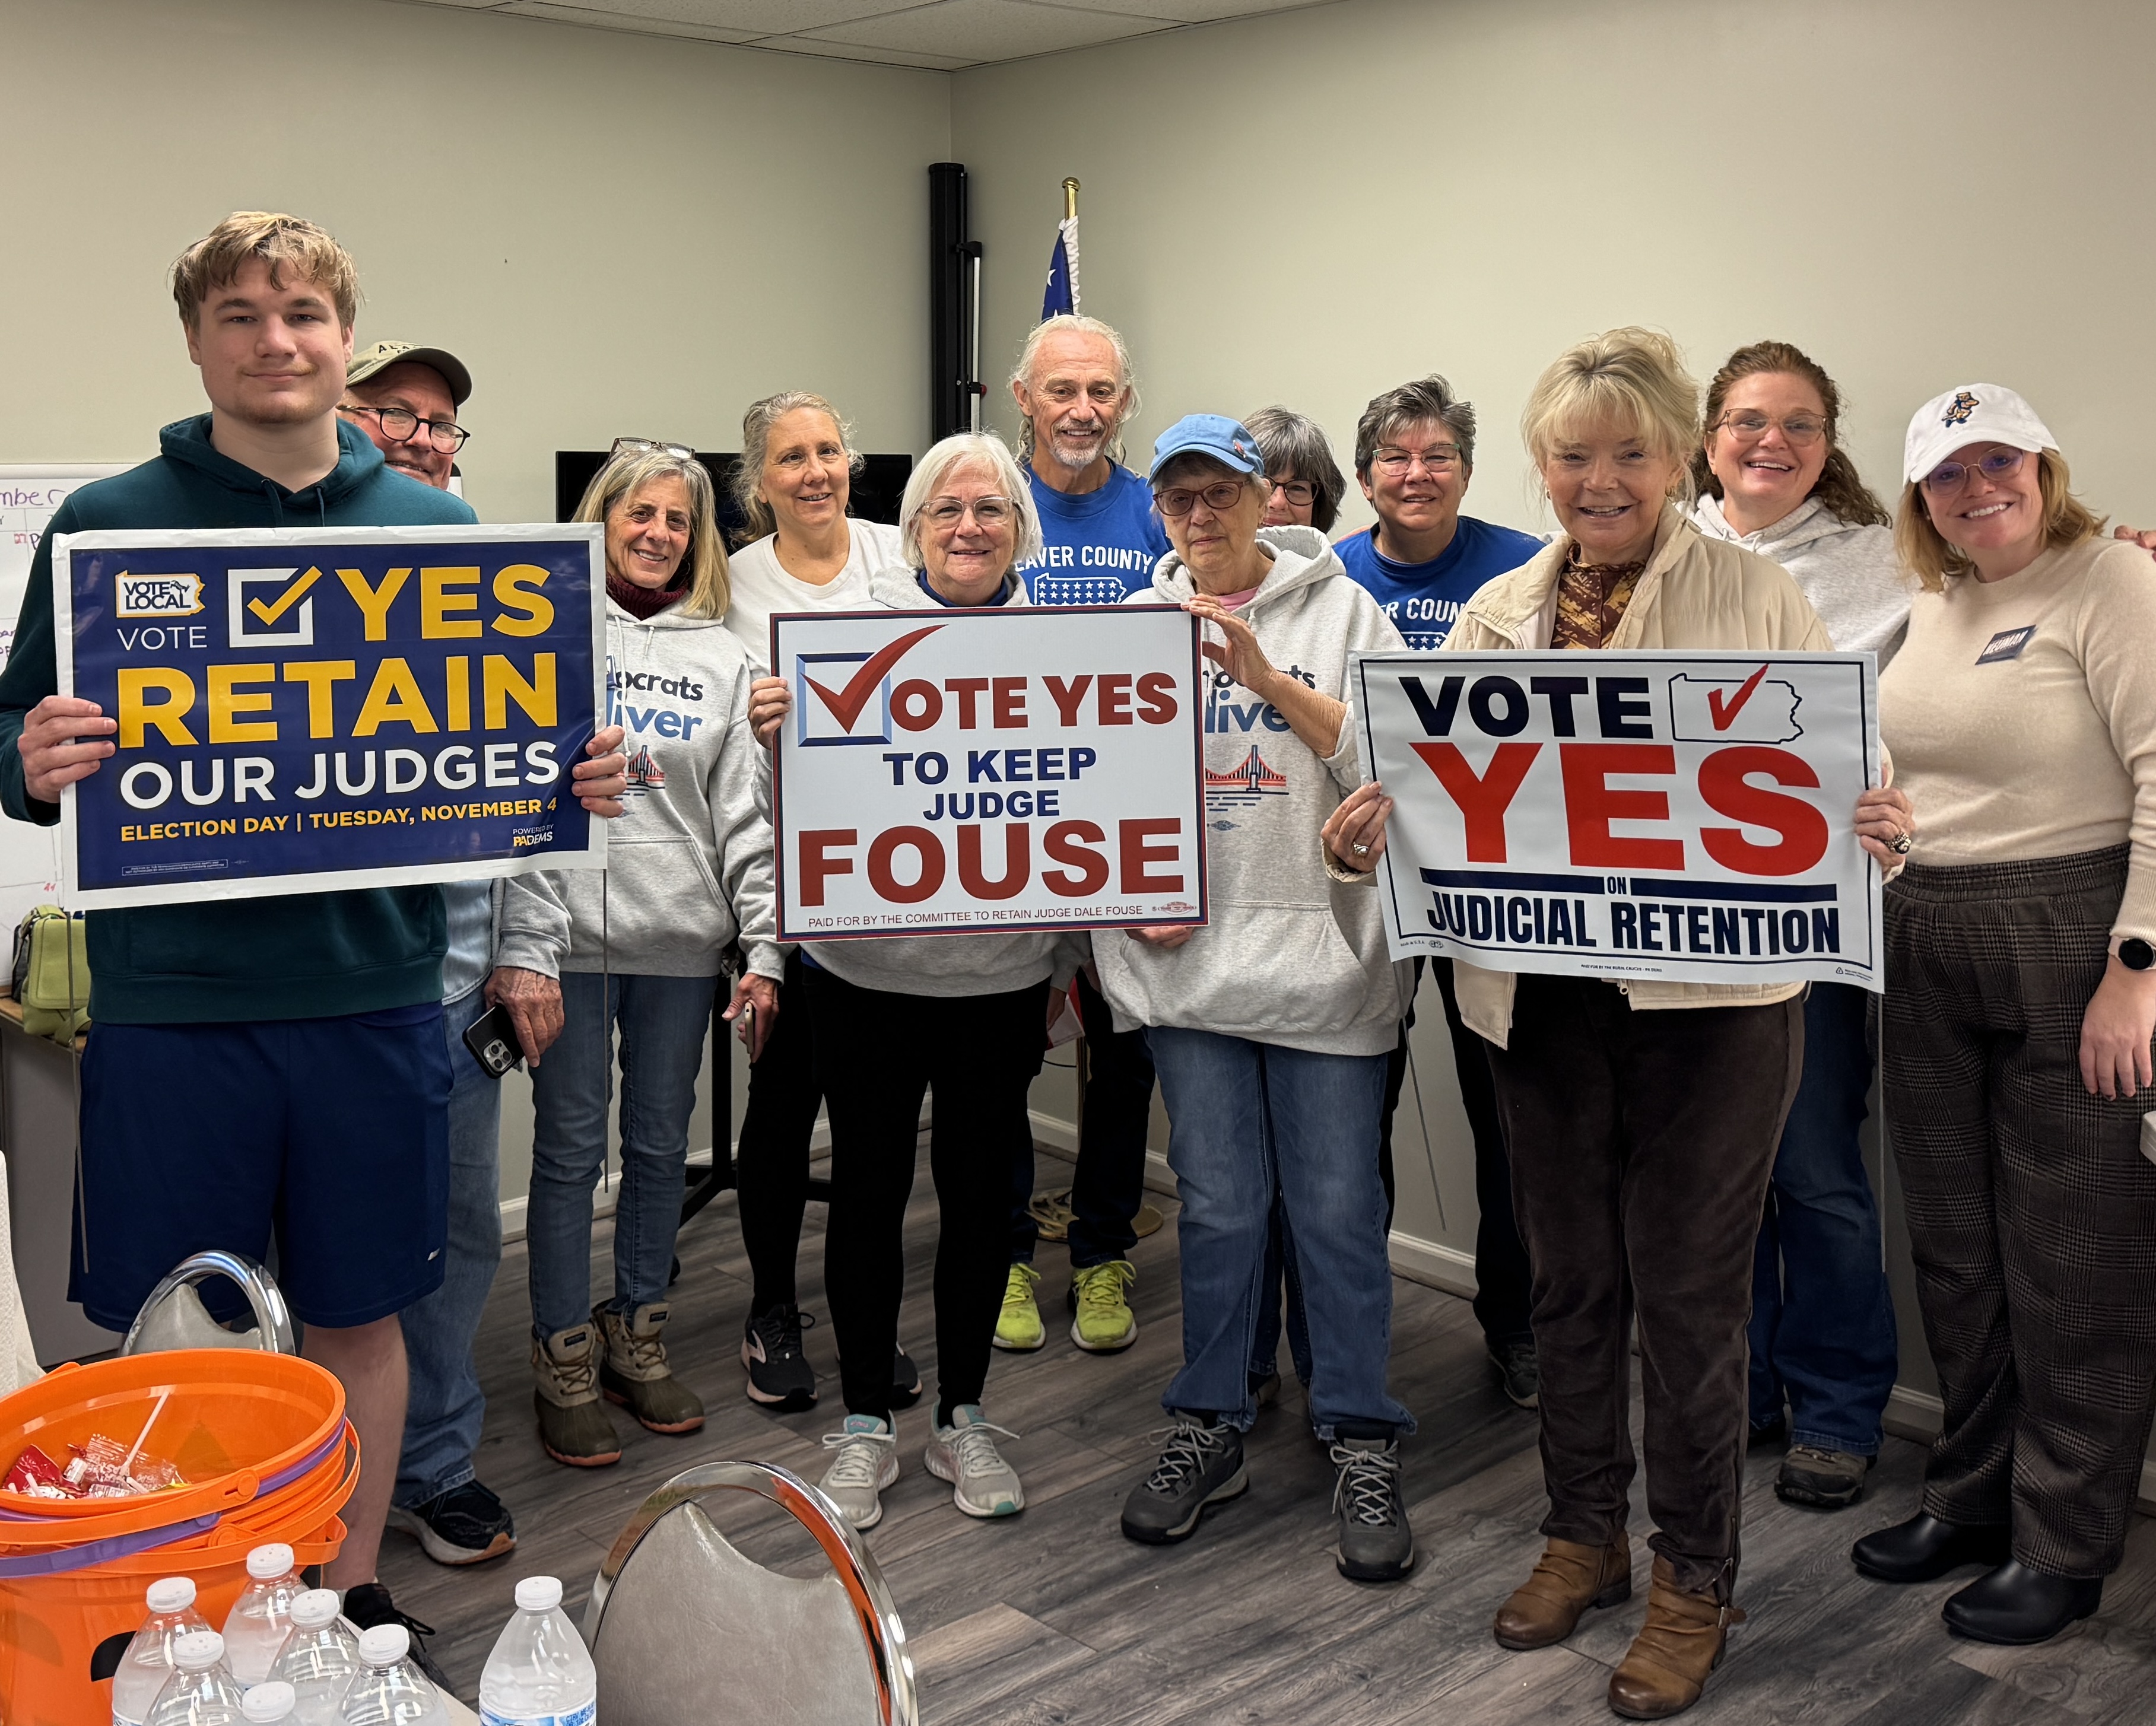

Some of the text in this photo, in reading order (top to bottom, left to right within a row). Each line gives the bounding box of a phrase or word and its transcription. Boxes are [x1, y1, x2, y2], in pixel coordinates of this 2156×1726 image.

[1081, 545, 1154, 574] COUNTY
[116, 564, 556, 651] VOTE YES
[123, 581, 170, 596] VOTE
[126, 594, 191, 610] LOCAL
[118, 653, 558, 749] RETAIN
[1042, 672, 1178, 726] YES
[1398, 675, 1654, 739] VOTE
[120, 741, 560, 809] OUR JUDGES
[882, 746, 1097, 786] TO KEEP
[121, 819, 236, 841] ELECTION
[244, 815, 289, 833] DAY
[309, 808, 415, 828] TUESDAY,
[421, 799, 542, 821] NOVEMBER
[547, 797, 557, 811] 4
[923, 790, 1060, 821] JUDGE
[1408, 742, 1828, 876] YES
[798, 818, 1185, 907] FOUSE
[1606, 875, 1628, 895] ON
[808, 917, 833, 927] PAID
[837, 916, 860, 926] FOR
[863, 916, 878, 924] BY
[881, 915, 902, 924] THE
[906, 911, 971, 924] COMMITTEE
[974, 911, 989, 920] TO
[992, 909, 1031, 920] RETAIN
[1034, 908, 1071, 918] JUDGE
[1074, 907, 1103, 917] DALE
[1106, 905, 1143, 916] FOUSE
[1427, 891, 1840, 957] JUDICIAL RETENTION
